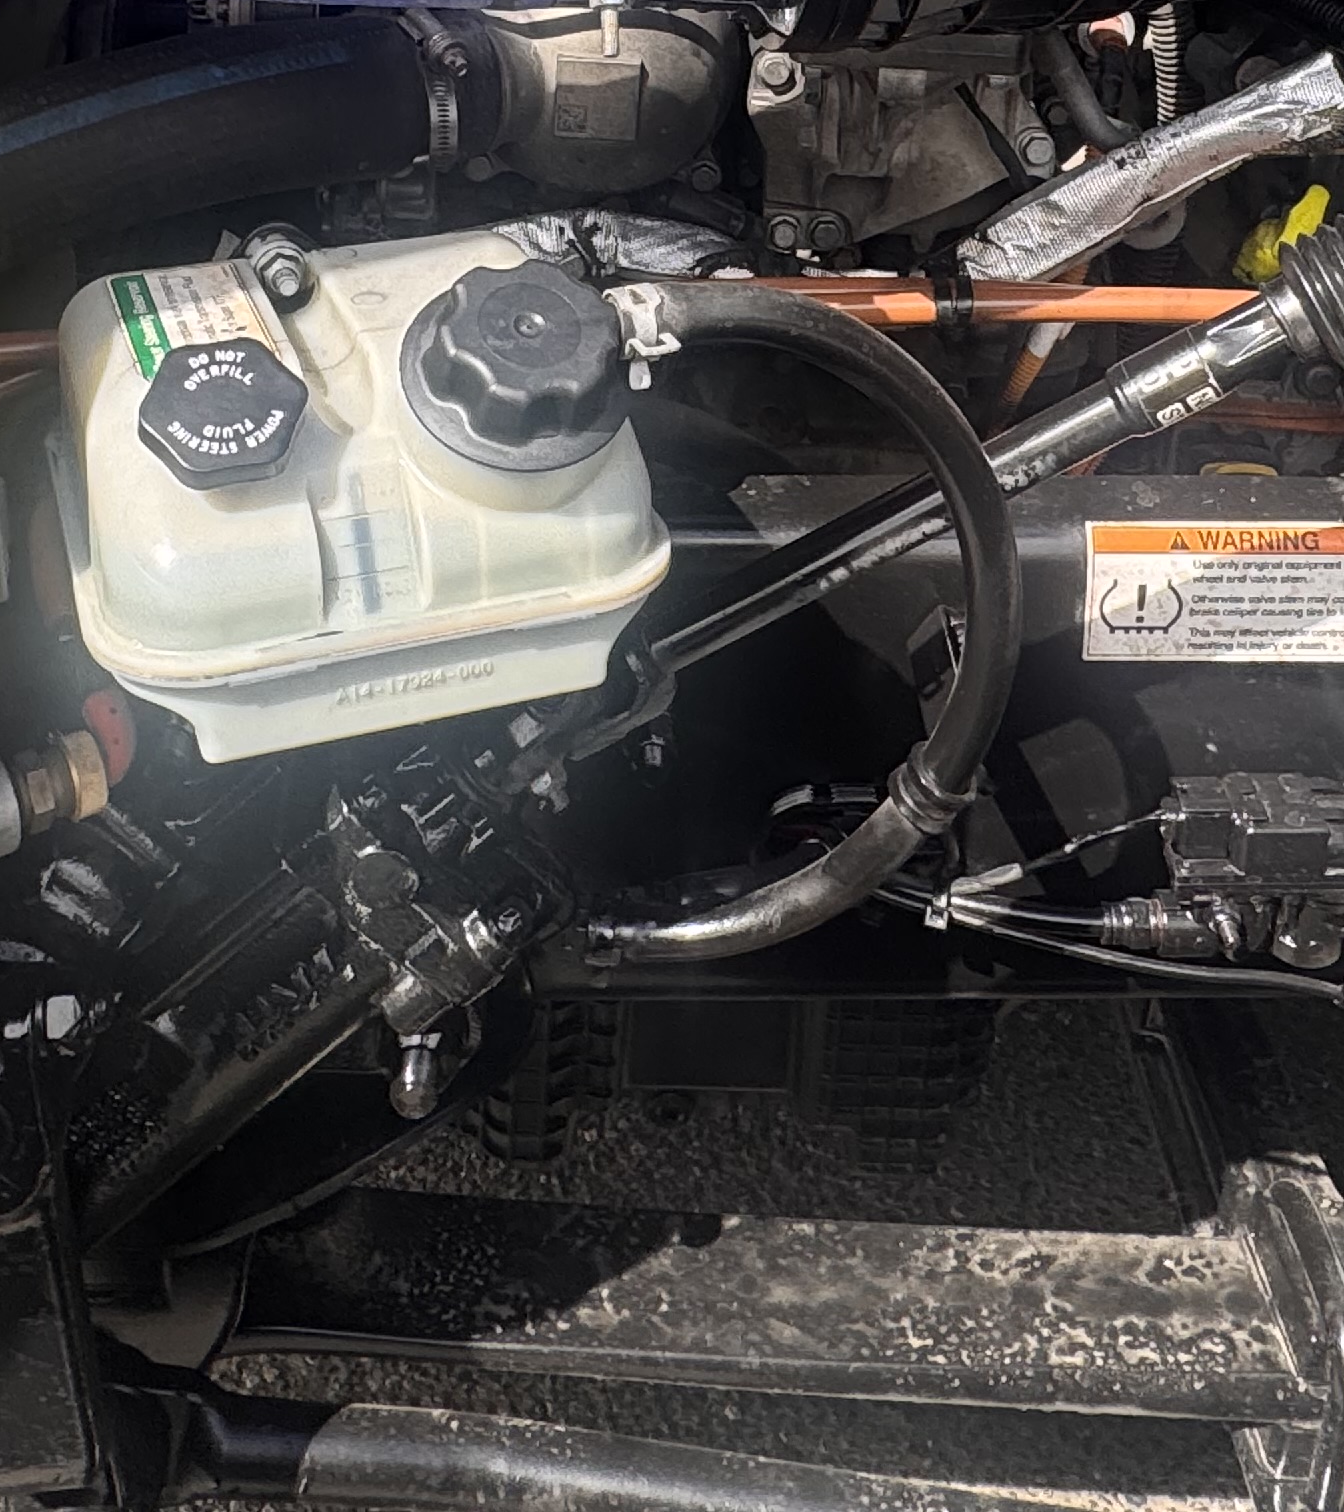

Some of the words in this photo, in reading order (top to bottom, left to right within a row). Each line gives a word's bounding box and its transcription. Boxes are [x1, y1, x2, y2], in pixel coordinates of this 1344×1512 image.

[188, 353, 209, 369] DO
[215, 350, 246, 364] NOT
[184, 364, 257, 391] OVERFILL
[203, 418, 255, 439] FLUID
[245, 410, 285, 448] POWER
[166, 420, 238, 455] STEERING
[1197, 530, 1320, 551] WARNING
[1193, 560, 1215, 570] Use
[1217, 561, 1239, 571] only
[1242, 560, 1283, 571] original
[1285, 560, 1342, 572] equipment
[1193, 575, 1223, 583] wheel
[1226, 575, 1247, 583] and
[1249, 575, 1277, 583] valve
[1191, 595, 1245, 604] Otherwise
[1248, 596, 1276, 604] valve
[1279, 596, 1304, 604] stem
[1307, 596, 1329, 606] may
[1189, 607, 1220, 617] brake
[1223, 607, 1259, 618] caliper
[1261, 608, 1303, 618] causing
[1306, 607, 1324, 616] tire
[1327, 608, 1338, 616] to
[1189, 627, 1211, 637] This
[1213, 629, 1235, 639] may
[1271, 628, 1309, 637] vehicle
[1187, 642, 1234, 652] resulting
